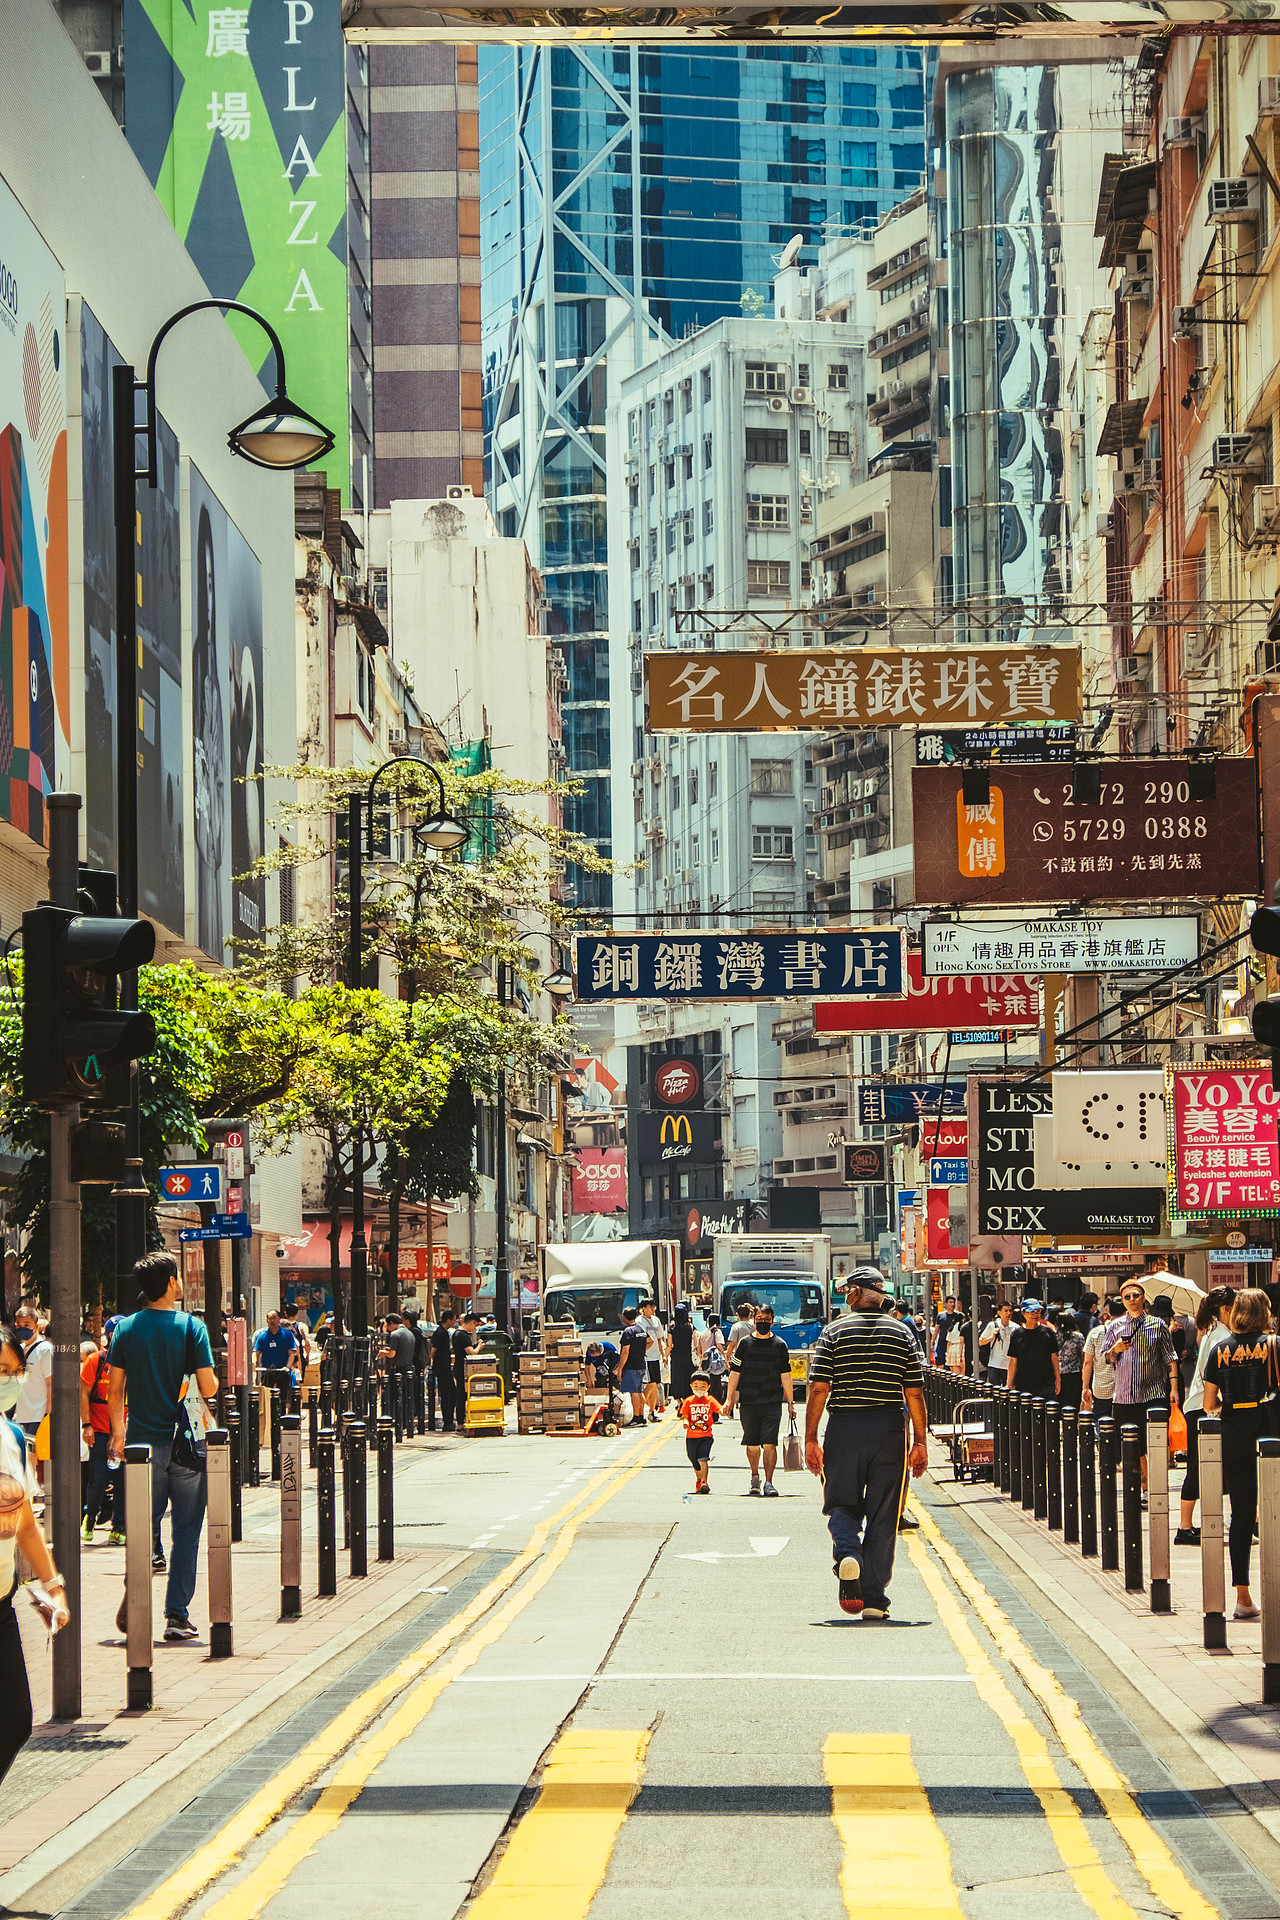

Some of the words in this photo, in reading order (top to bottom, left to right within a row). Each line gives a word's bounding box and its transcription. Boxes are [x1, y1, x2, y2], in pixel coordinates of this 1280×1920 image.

[206, 7, 251, 141] 廣場
[0, 262, 18, 315] OGO
[1048, 727, 1071, 739] 4/F
[1062, 783, 1125, 806] 272
[1144, 781, 1204, 803] 290
[1063, 819, 1126, 841] 5729
[1144, 816, 1208, 839] 0388
[1024, 922, 1078, 933] OMAKASE
[1081, 921, 1104, 932] TOY
[936, 931, 957, 942] 1/F
[933, 944, 960, 953] OPEN
[972, 938, 1166, 959] 情趣用品香港旗艦店
[591, 938, 889, 992] 銅鑼灣書店
[668, 1085, 688, 1097] Hut
[1187, 1134, 1220, 1144] Beauty
[1222, 1132, 1256, 1142] service
[1184, 1147, 1271, 1168] 嫁接睫毛
[1183, 1170, 1227, 1181] Eyelashes
[1229, 1168, 1272, 1179] extension
[587, 1180, 611, 1192] 莎莎
[1185, 1181, 1231, 1207] 3/F
[1239, 1185, 1268, 1202] TEL:
[986, 1206, 1047, 1231] SEX
[1087, 1214, 1135, 1224] OMAKASE
[1135, 1215, 1156, 1224] TOY
[690, 1406, 710, 1415] BABY
